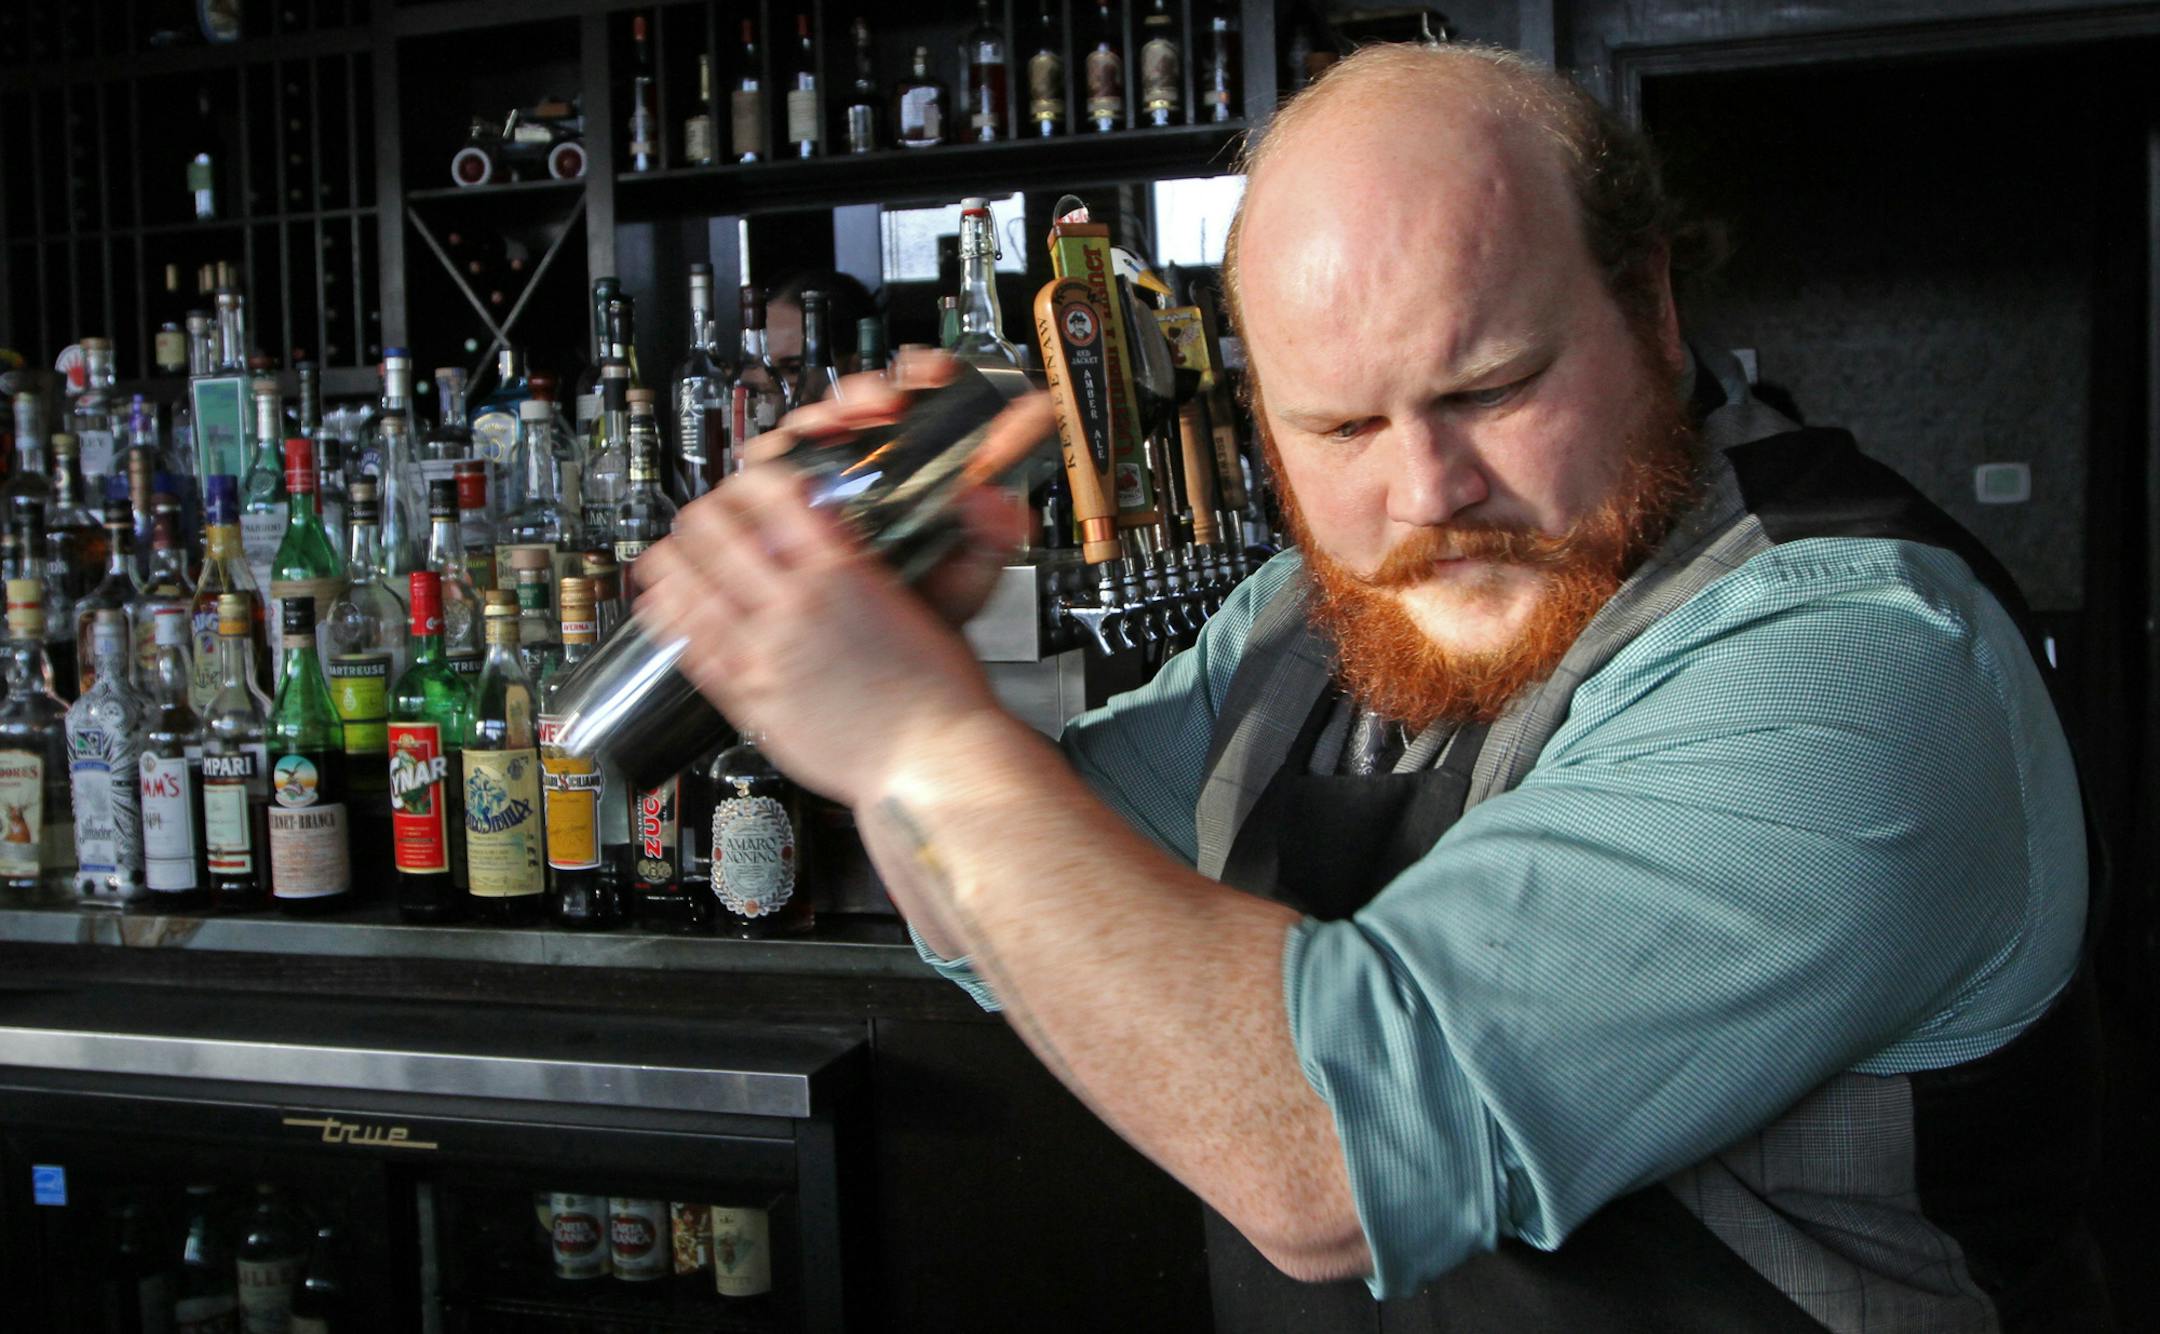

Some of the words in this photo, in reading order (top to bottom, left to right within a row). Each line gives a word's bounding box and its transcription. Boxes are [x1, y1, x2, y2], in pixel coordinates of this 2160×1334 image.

[1038, 318, 1077, 469] KEWEENAW
[1083, 369, 1098, 420] AMBER
[1094, 430, 1105, 460] ALE
[328, 664, 385, 677] ARTREUSE
[203, 757, 252, 776] MPARI
[269, 811, 336, 831] ERNET-BRANCA
[726, 836, 777, 851] AMARO
[726, 850, 778, 865] NONINO
